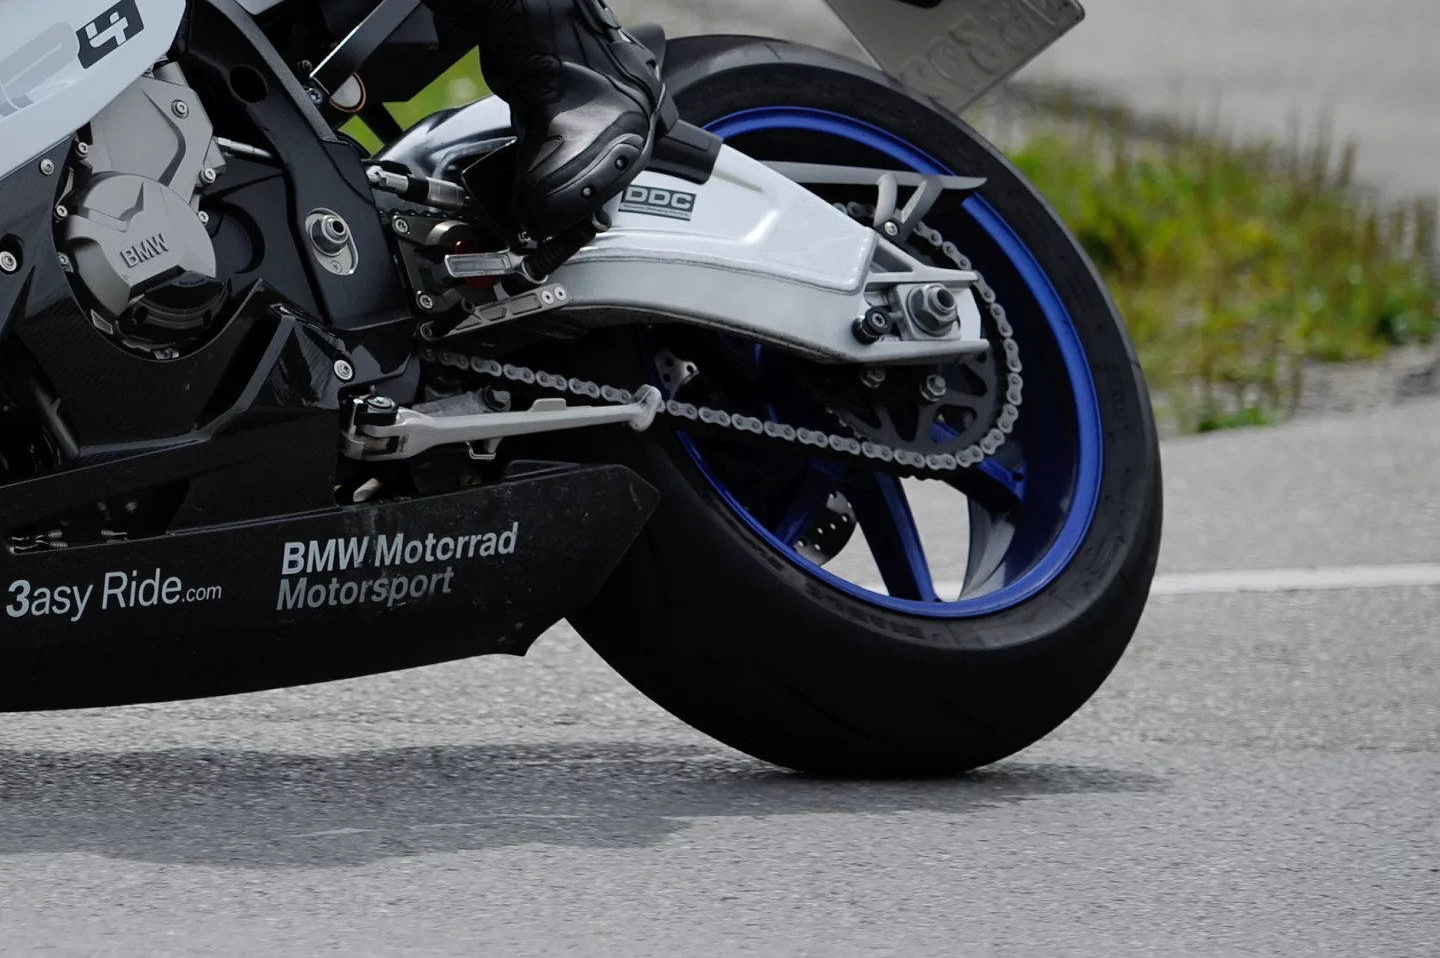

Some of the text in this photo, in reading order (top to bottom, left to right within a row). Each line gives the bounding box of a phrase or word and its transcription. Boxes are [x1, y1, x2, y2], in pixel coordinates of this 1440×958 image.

[624, 186, 693, 210] DDC
[119, 233, 169, 268] BMW
[281, 521, 520, 576] BMW Motorrad
[5, 567, 223, 622] 3asy Ride.com
[276, 566, 455, 611] Motorsport
